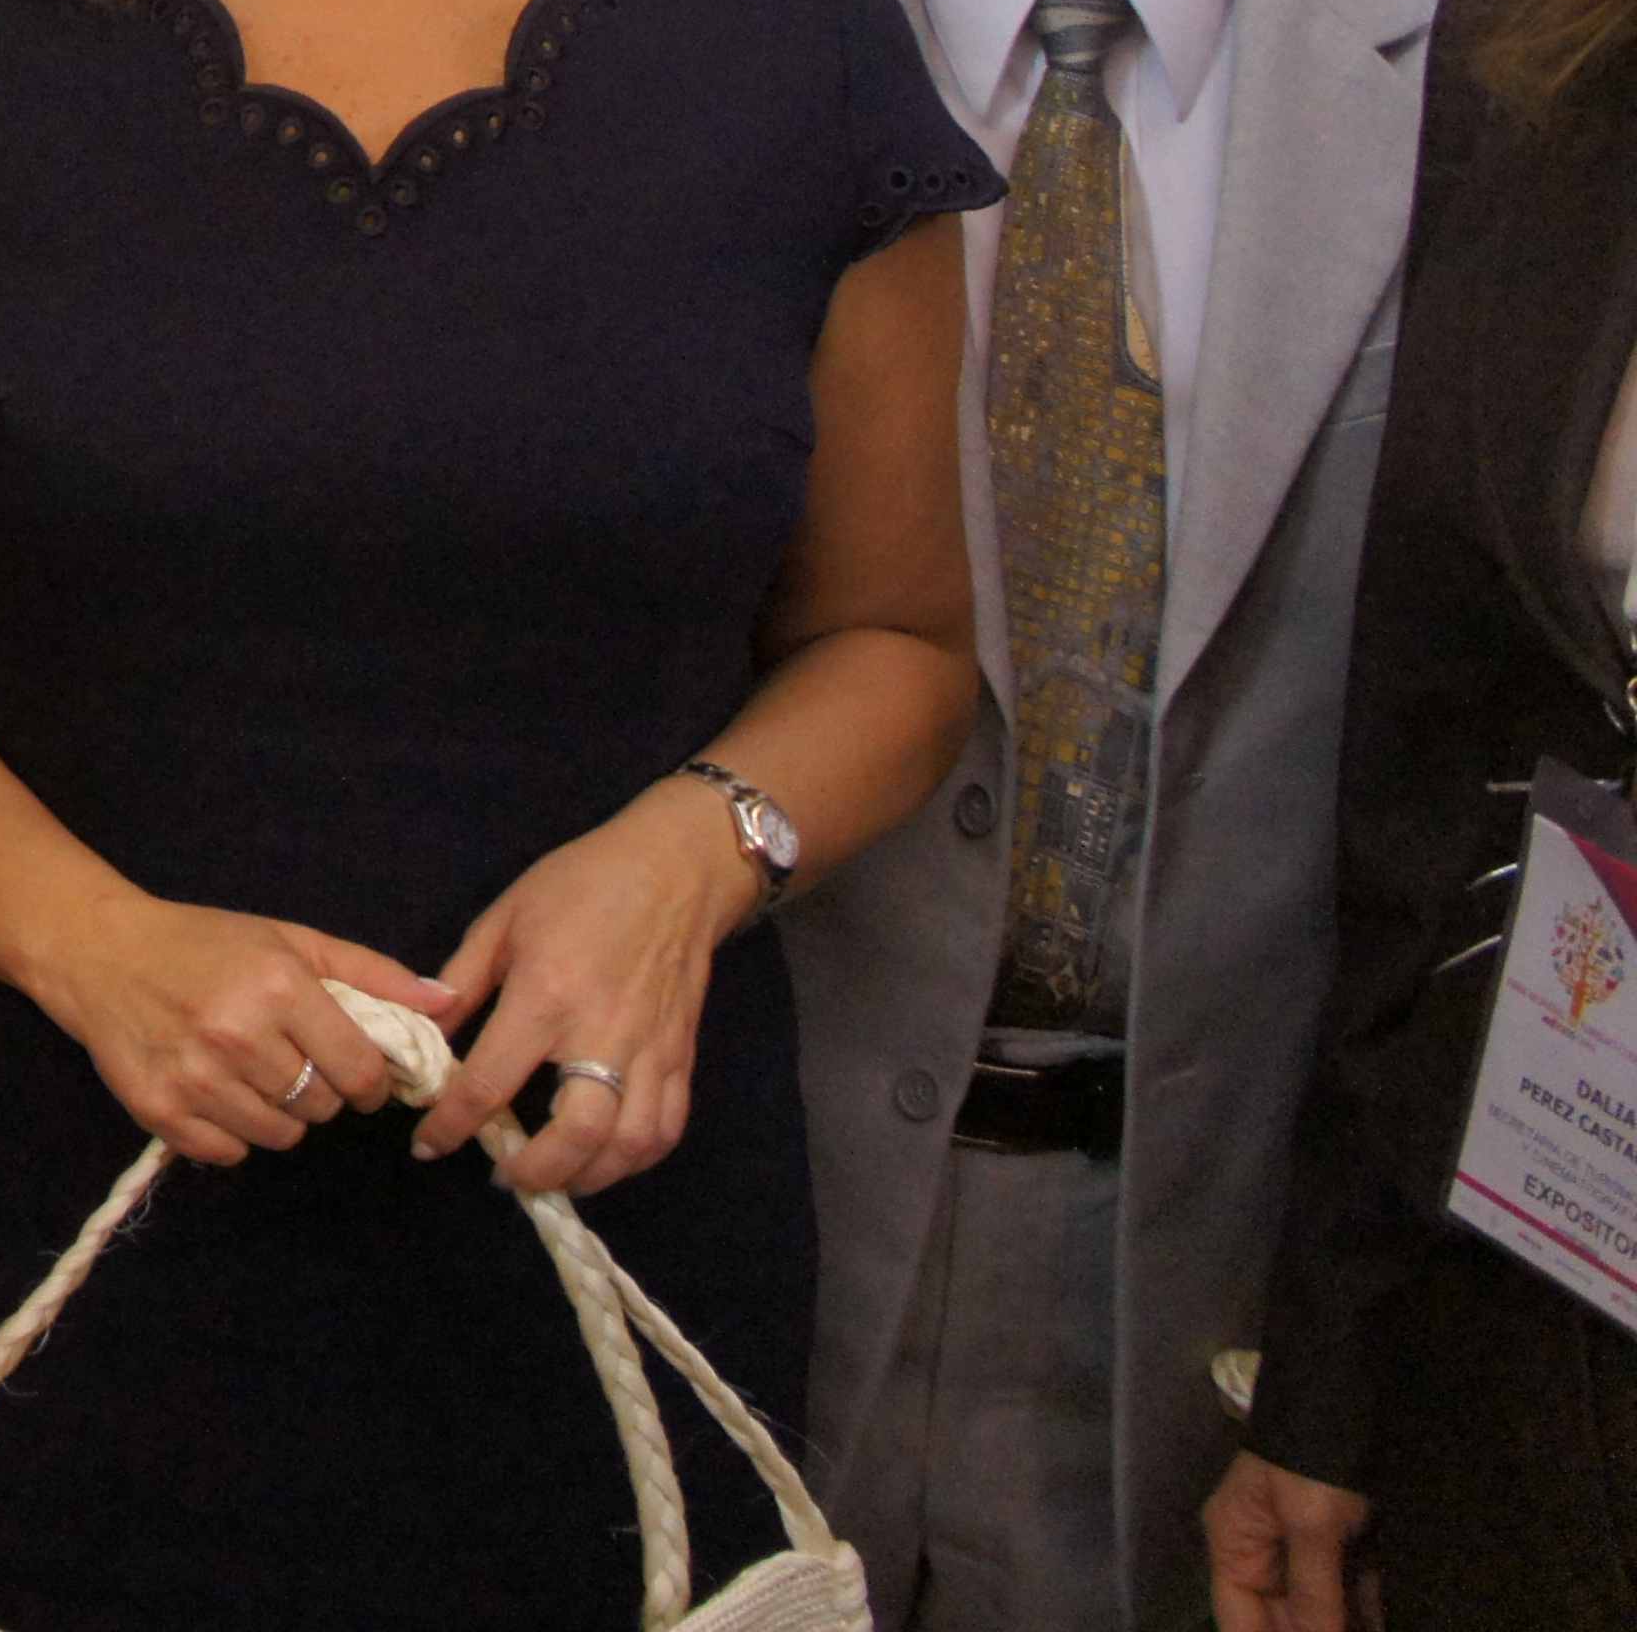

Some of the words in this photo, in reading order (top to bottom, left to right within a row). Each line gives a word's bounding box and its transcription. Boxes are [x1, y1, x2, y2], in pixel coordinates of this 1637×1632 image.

[1520, 1077, 1574, 1123] PEREZ
[1579, 1114, 1637, 1165] CASTA
[1577, 1079, 1637, 1129] DALIA
